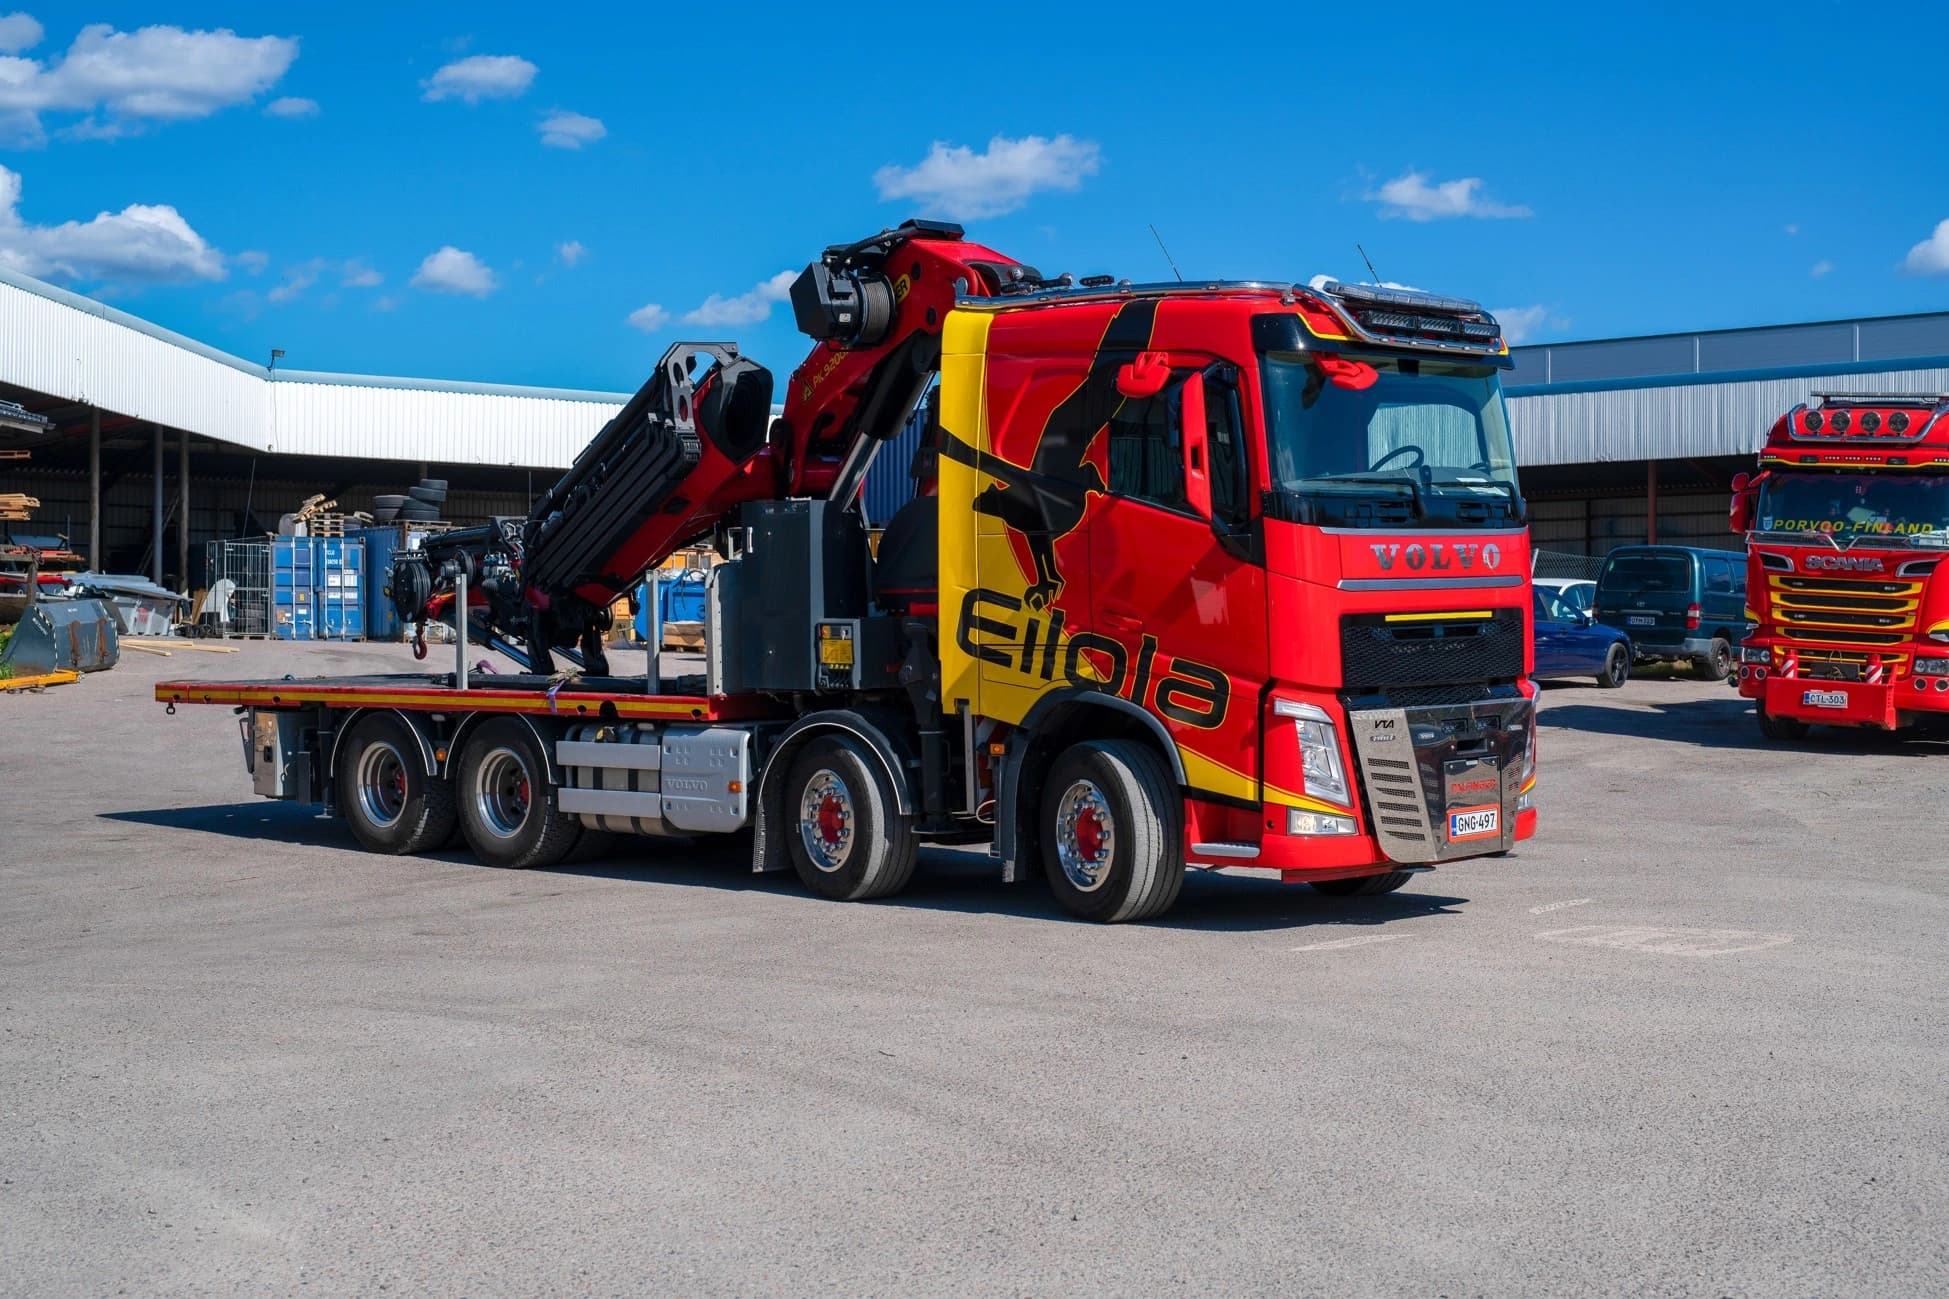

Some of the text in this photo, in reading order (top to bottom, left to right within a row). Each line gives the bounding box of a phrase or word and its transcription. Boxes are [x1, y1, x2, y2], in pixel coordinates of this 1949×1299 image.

[1773, 519, 1934, 534] PORVOO-FINLAND
[1370, 543, 1500, 570] VOLVO
[1805, 555, 1885, 572] SCANIA
[957, 588, 1231, 730] Eilola
[1810, 694, 1845, 705] CTL-303
[1375, 719, 1394, 729] VTA
[665, 779, 708, 791] VOLVO
[1458, 813, 1495, 832] GNG-497
